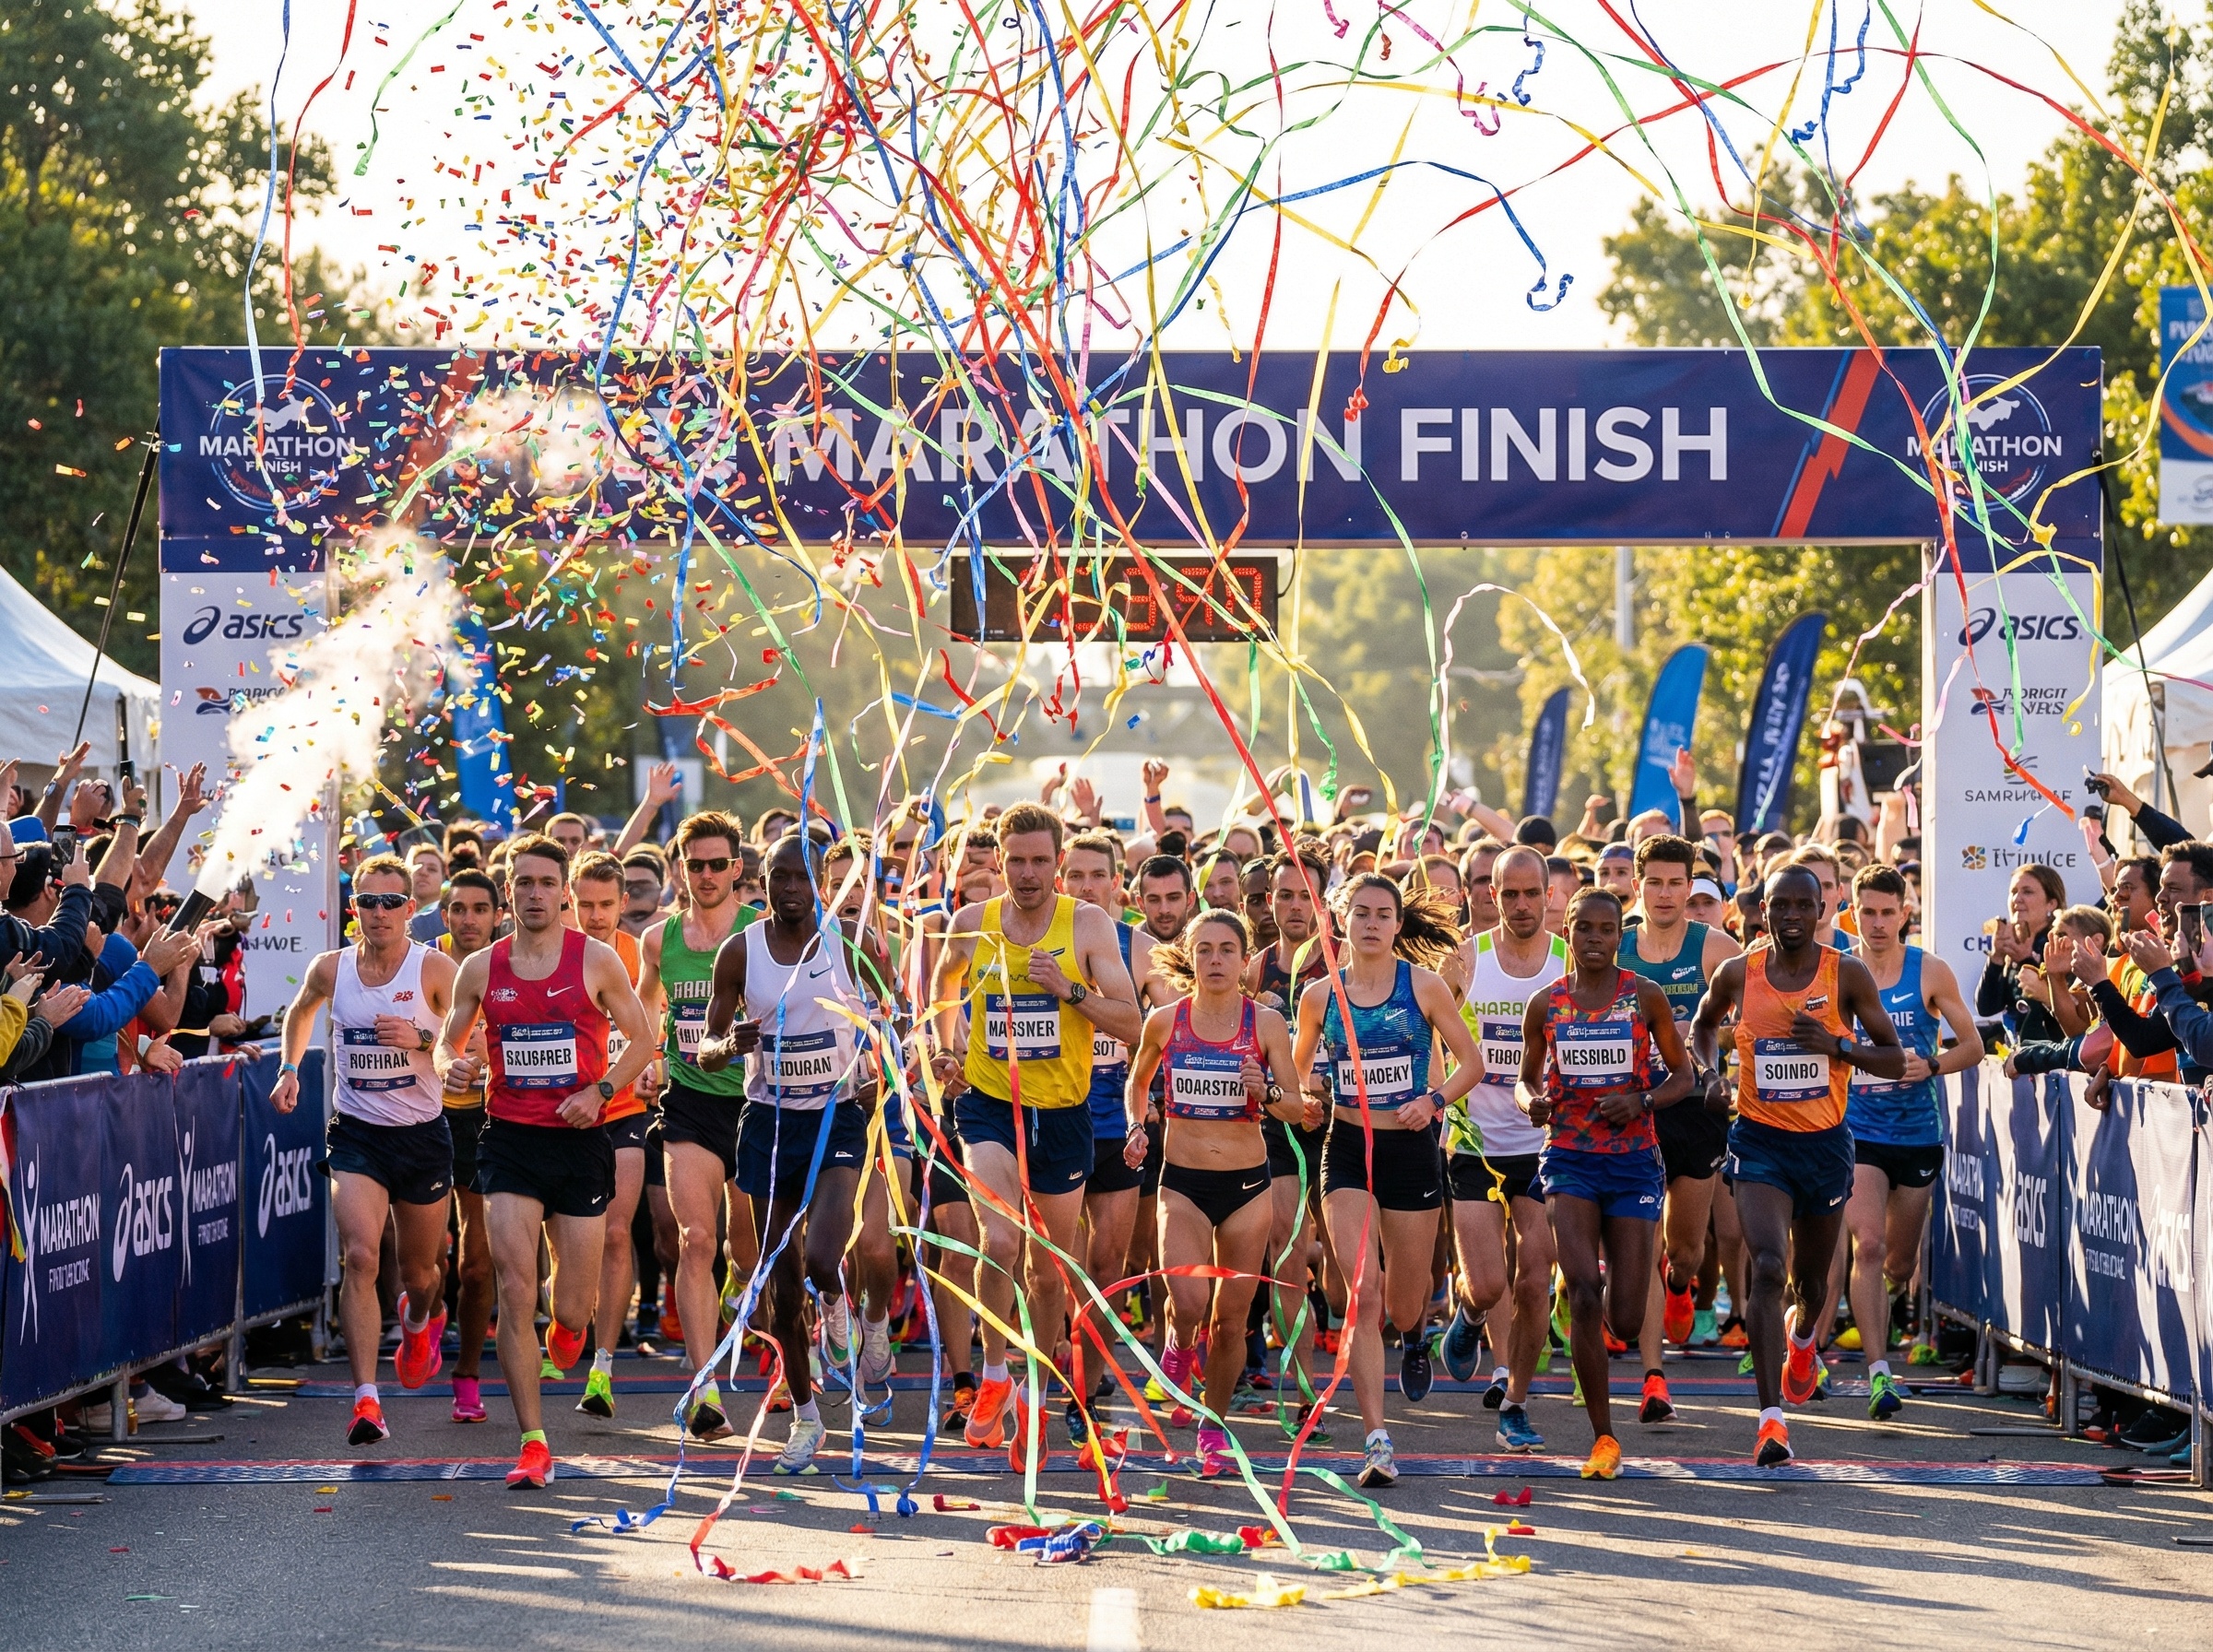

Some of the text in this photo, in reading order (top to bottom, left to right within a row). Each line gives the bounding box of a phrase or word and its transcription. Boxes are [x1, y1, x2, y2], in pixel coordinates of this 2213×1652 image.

[199, 435, 356, 457] MARATHON
[774, 407, 1362, 483] MARATHON
[1401, 407, 1727, 482] FINISH
[1907, 435, 2062, 457] MATHON
[245, 460, 302, 473] FNISH
[222, 614, 304, 639] asics
[40, 1192, 101, 1255] MARATHON
[133, 1175, 172, 1257] asics
[2081, 1191, 2136, 1245] MARATHON
